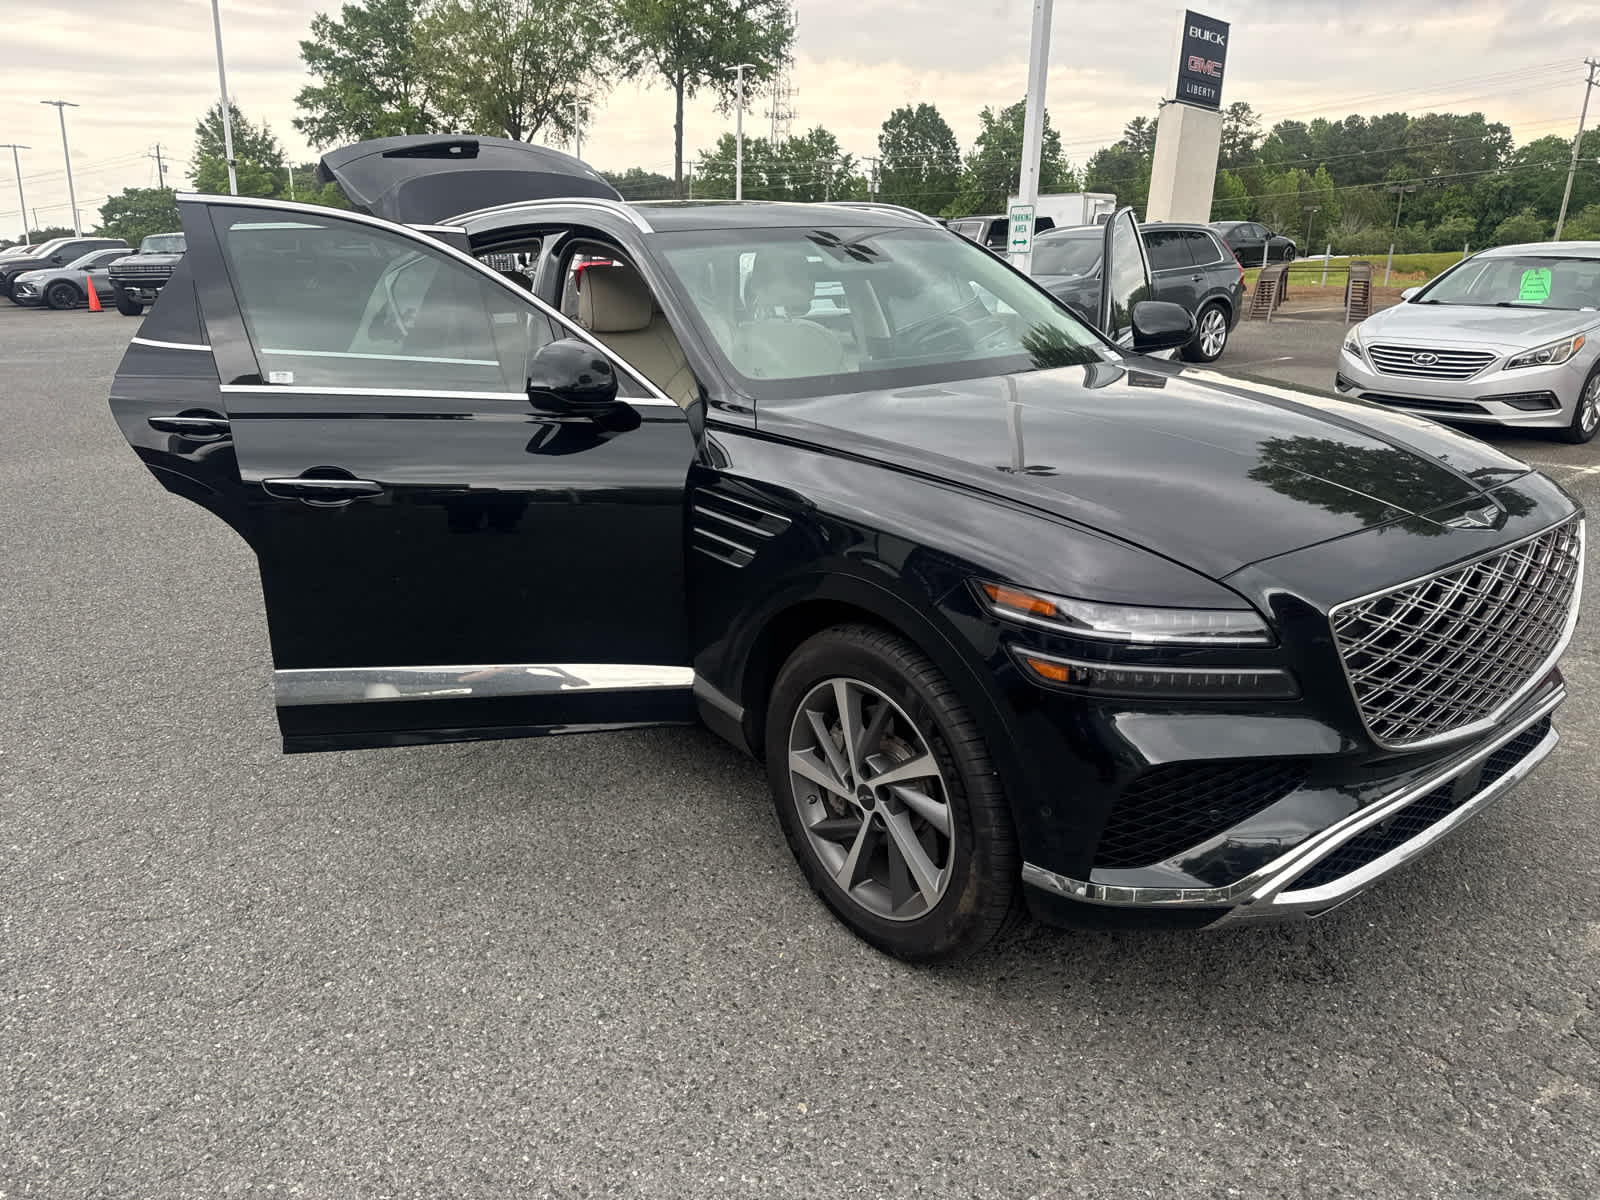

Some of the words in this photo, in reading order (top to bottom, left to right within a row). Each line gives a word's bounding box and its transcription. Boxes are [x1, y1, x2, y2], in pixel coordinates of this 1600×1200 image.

[1189, 26, 1225, 46] BUICK
[1187, 55, 1222, 78] GMC
[1186, 82, 1216, 98] LIBERTY
[1011, 213, 1032, 222] PARKING
[1014, 224, 1027, 233] AREA
